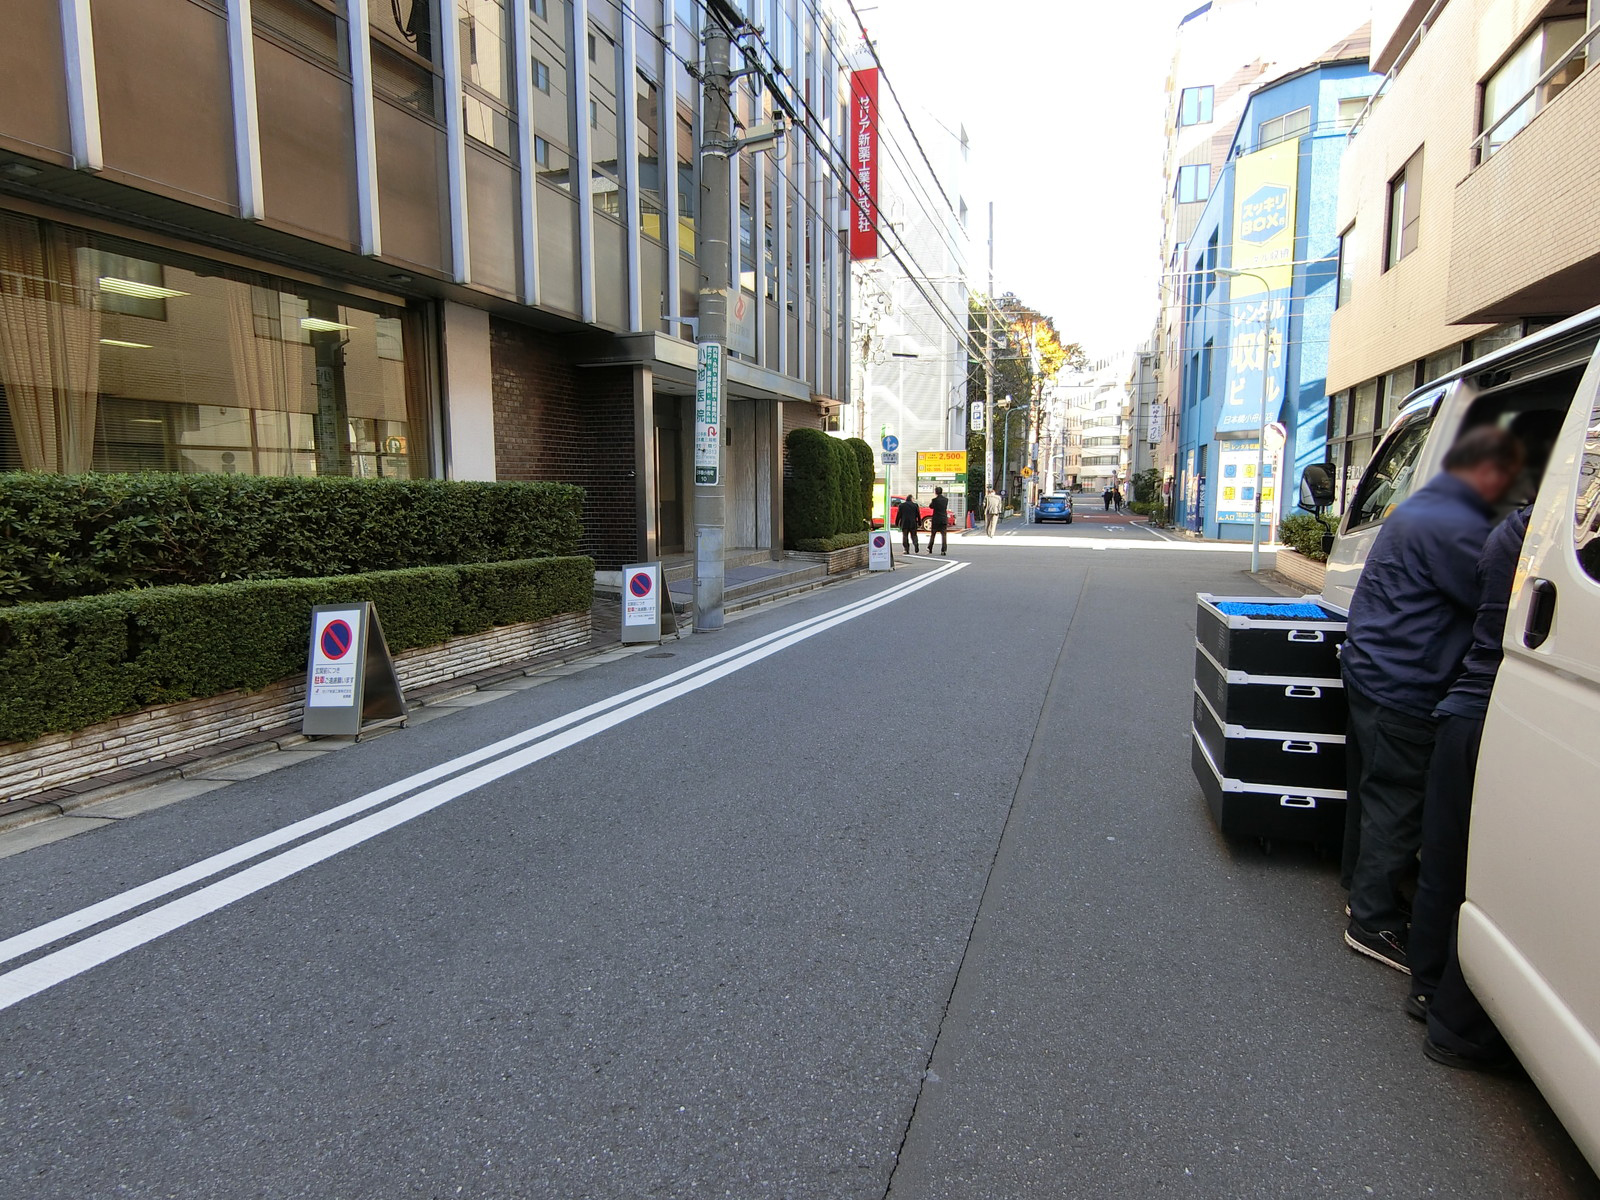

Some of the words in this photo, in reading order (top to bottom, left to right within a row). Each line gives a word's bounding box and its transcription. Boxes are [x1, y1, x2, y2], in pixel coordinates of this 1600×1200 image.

[1243, 193, 1287, 220] スッキリ
[1242, 213, 1279, 235] BOX
[1234, 298, 1284, 327] レンタル
[1231, 328, 1282, 373] 収納
